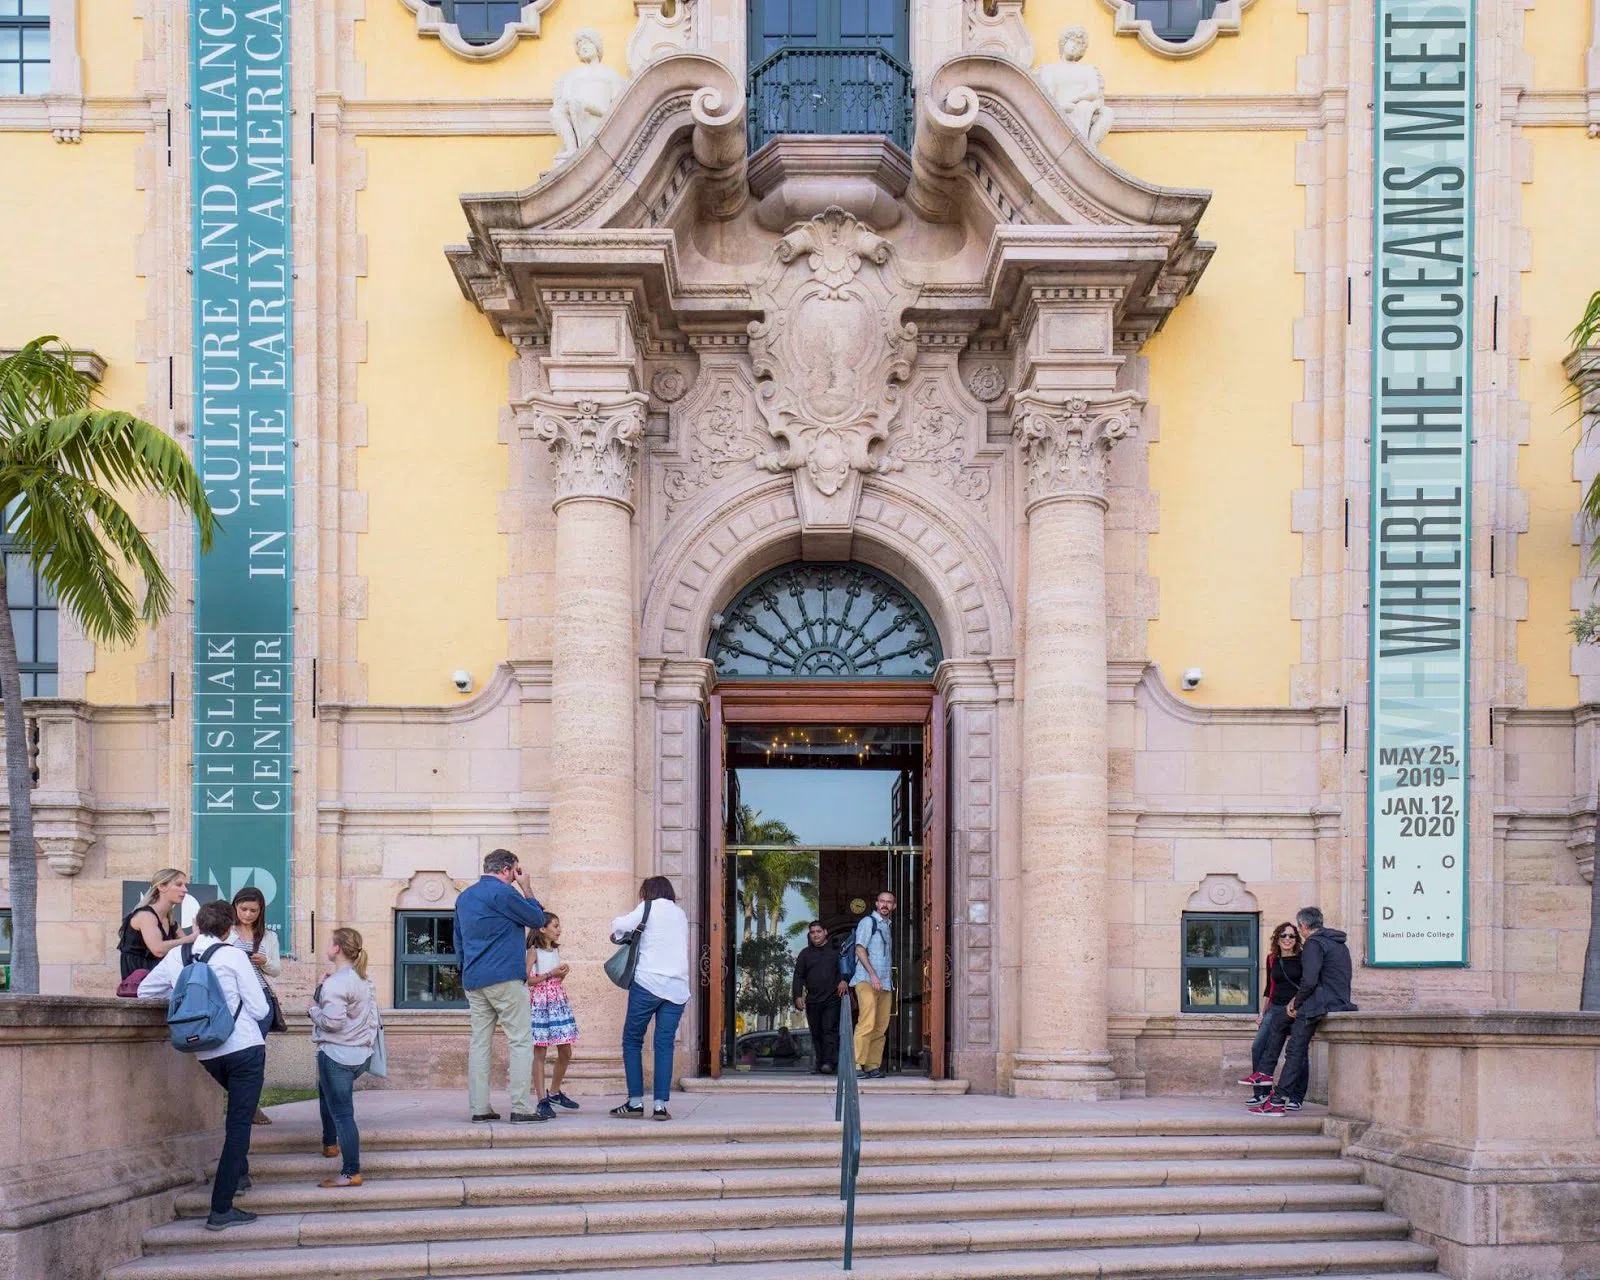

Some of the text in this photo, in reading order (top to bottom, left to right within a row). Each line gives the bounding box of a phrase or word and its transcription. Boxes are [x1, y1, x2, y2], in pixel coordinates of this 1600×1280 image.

[1383, 13, 1466, 141] MEET
[198, 0, 241, 516] CULTURE AND CHANG
[244, 0, 287, 579] IN THE EARLY AMERICA
[1381, 166, 1465, 351] OCEANS
[1381, 376, 1463, 464] THE
[1379, 487, 1461, 658] WHERE
[206, 637, 235, 811] KISLAK
[252, 637, 282, 811] CENTER
[1379, 745, 1460, 767] MAY 25,
[1381, 795, 1460, 817] JAN. 12,
[1400, 816, 1455, 837] 2020
[1382, 931, 1404, 939] Miami
[1426, 931, 1455, 939] College
